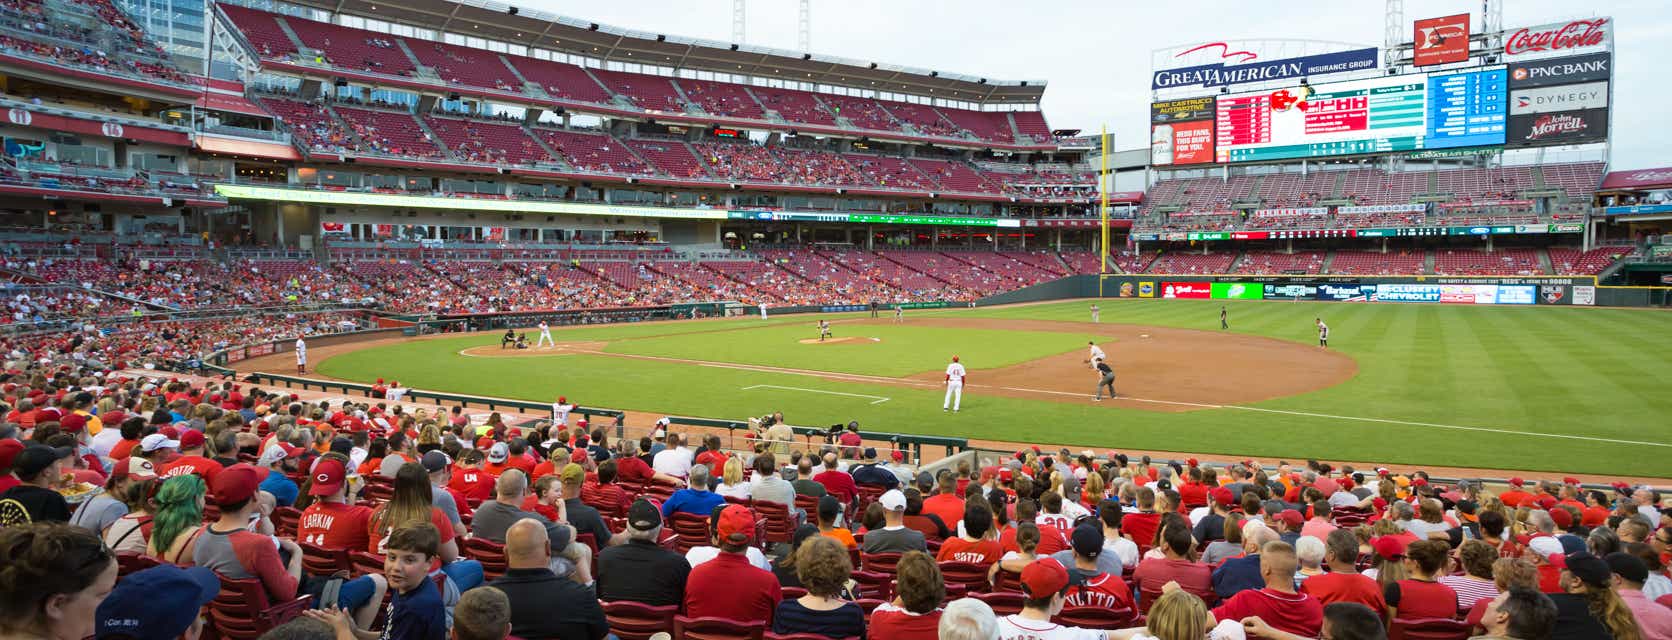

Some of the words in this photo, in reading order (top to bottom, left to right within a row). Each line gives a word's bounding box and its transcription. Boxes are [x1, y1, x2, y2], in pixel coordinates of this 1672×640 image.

[1505, 18, 1608, 55] Coca-Cola
[1155, 69, 1214, 87] GREAT
[1206, 62, 1303, 86] AMERICAN
[1308, 62, 1346, 73] INSURANCE
[1349, 59, 1373, 69] GROUP
[1530, 65, 1562, 78] PNC
[1564, 59, 1607, 75] BANK
[1537, 91, 1598, 104] DYNEGY
[1526, 117, 1582, 140] Morrell
[1551, 114, 1573, 124] John
[1176, 144, 1190, 152] FOR
[303, 512, 335, 531] LARKIN
